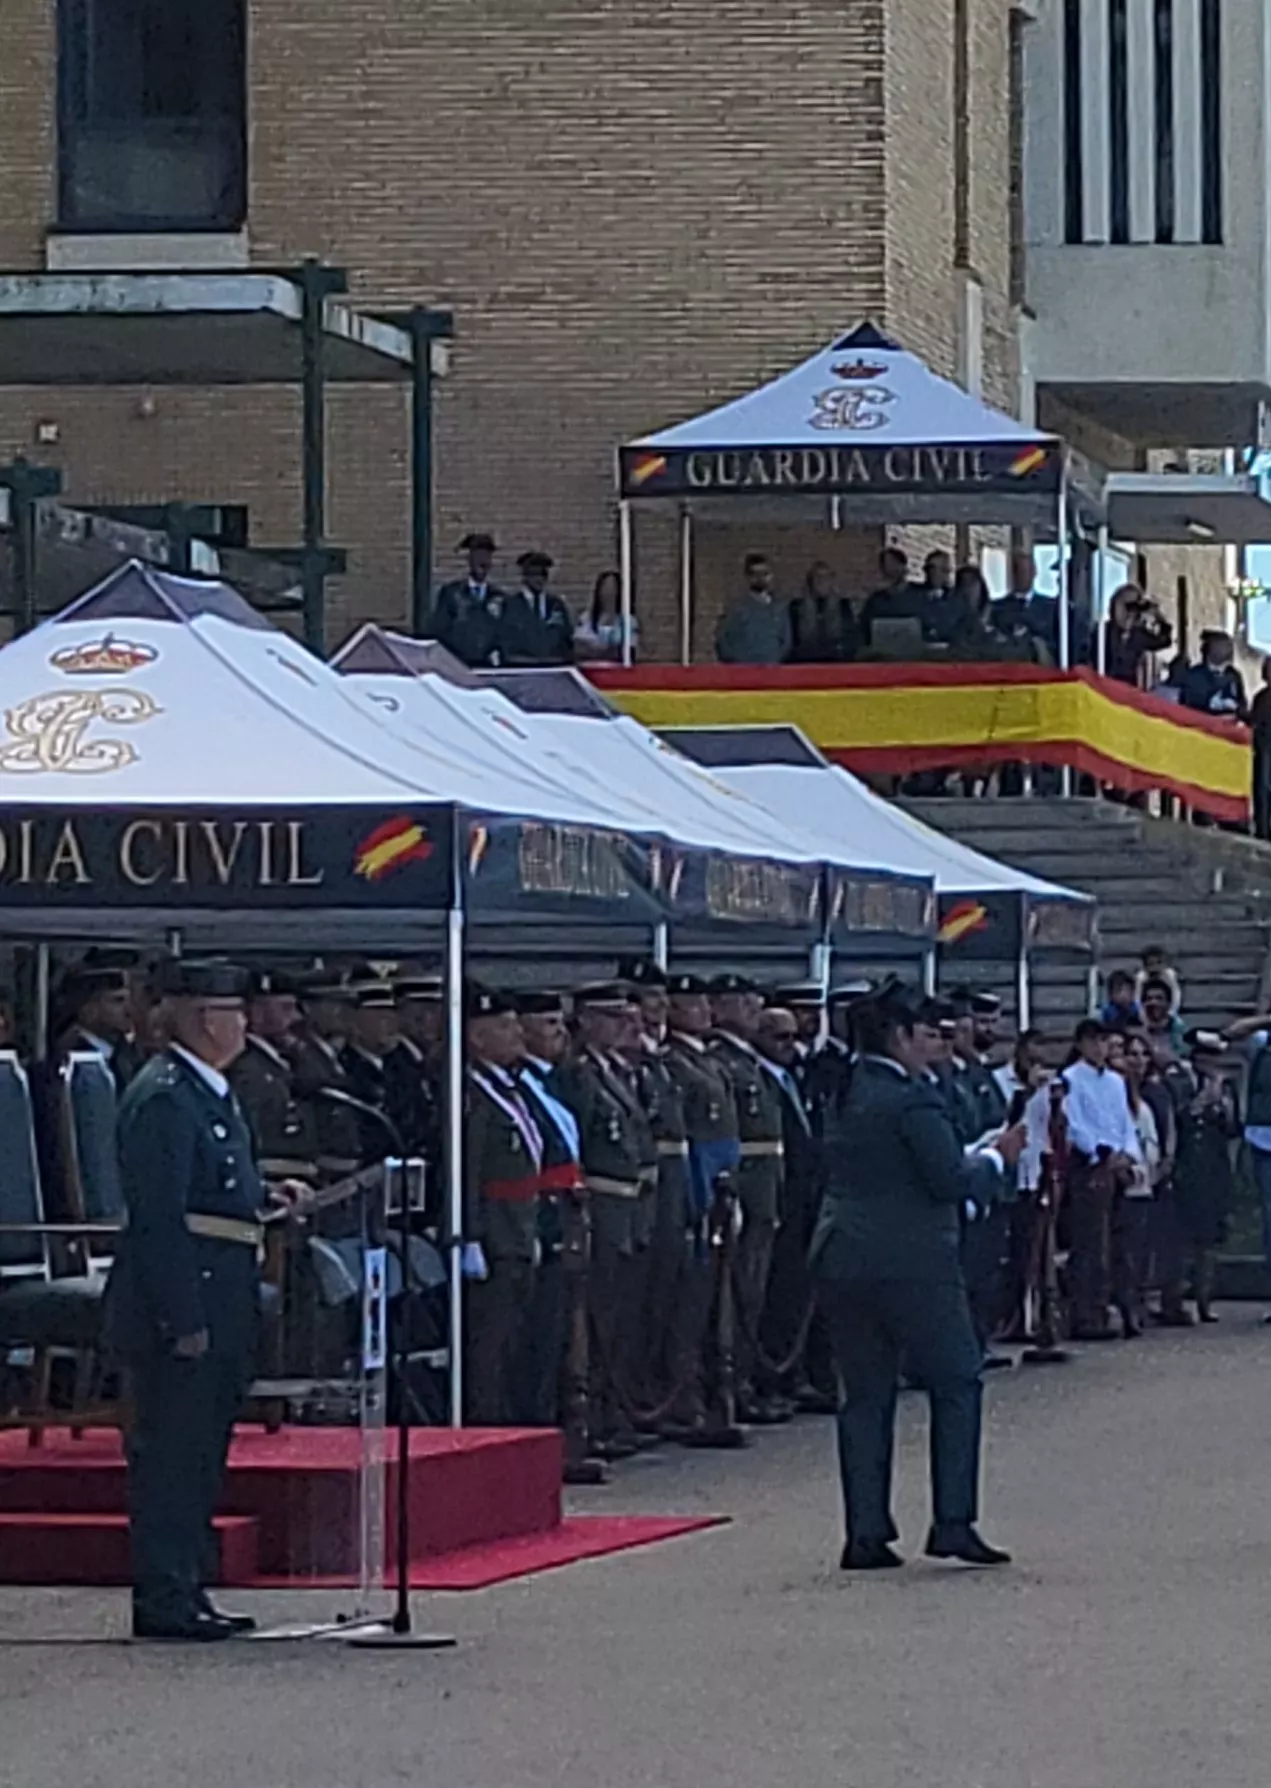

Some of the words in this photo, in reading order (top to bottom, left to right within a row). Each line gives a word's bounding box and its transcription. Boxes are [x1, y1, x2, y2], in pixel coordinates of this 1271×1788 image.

[687, 448, 871, 487] GUARDIA
[884, 447, 992, 482] CIVIL
[120, 820, 325, 885] CIVIL
